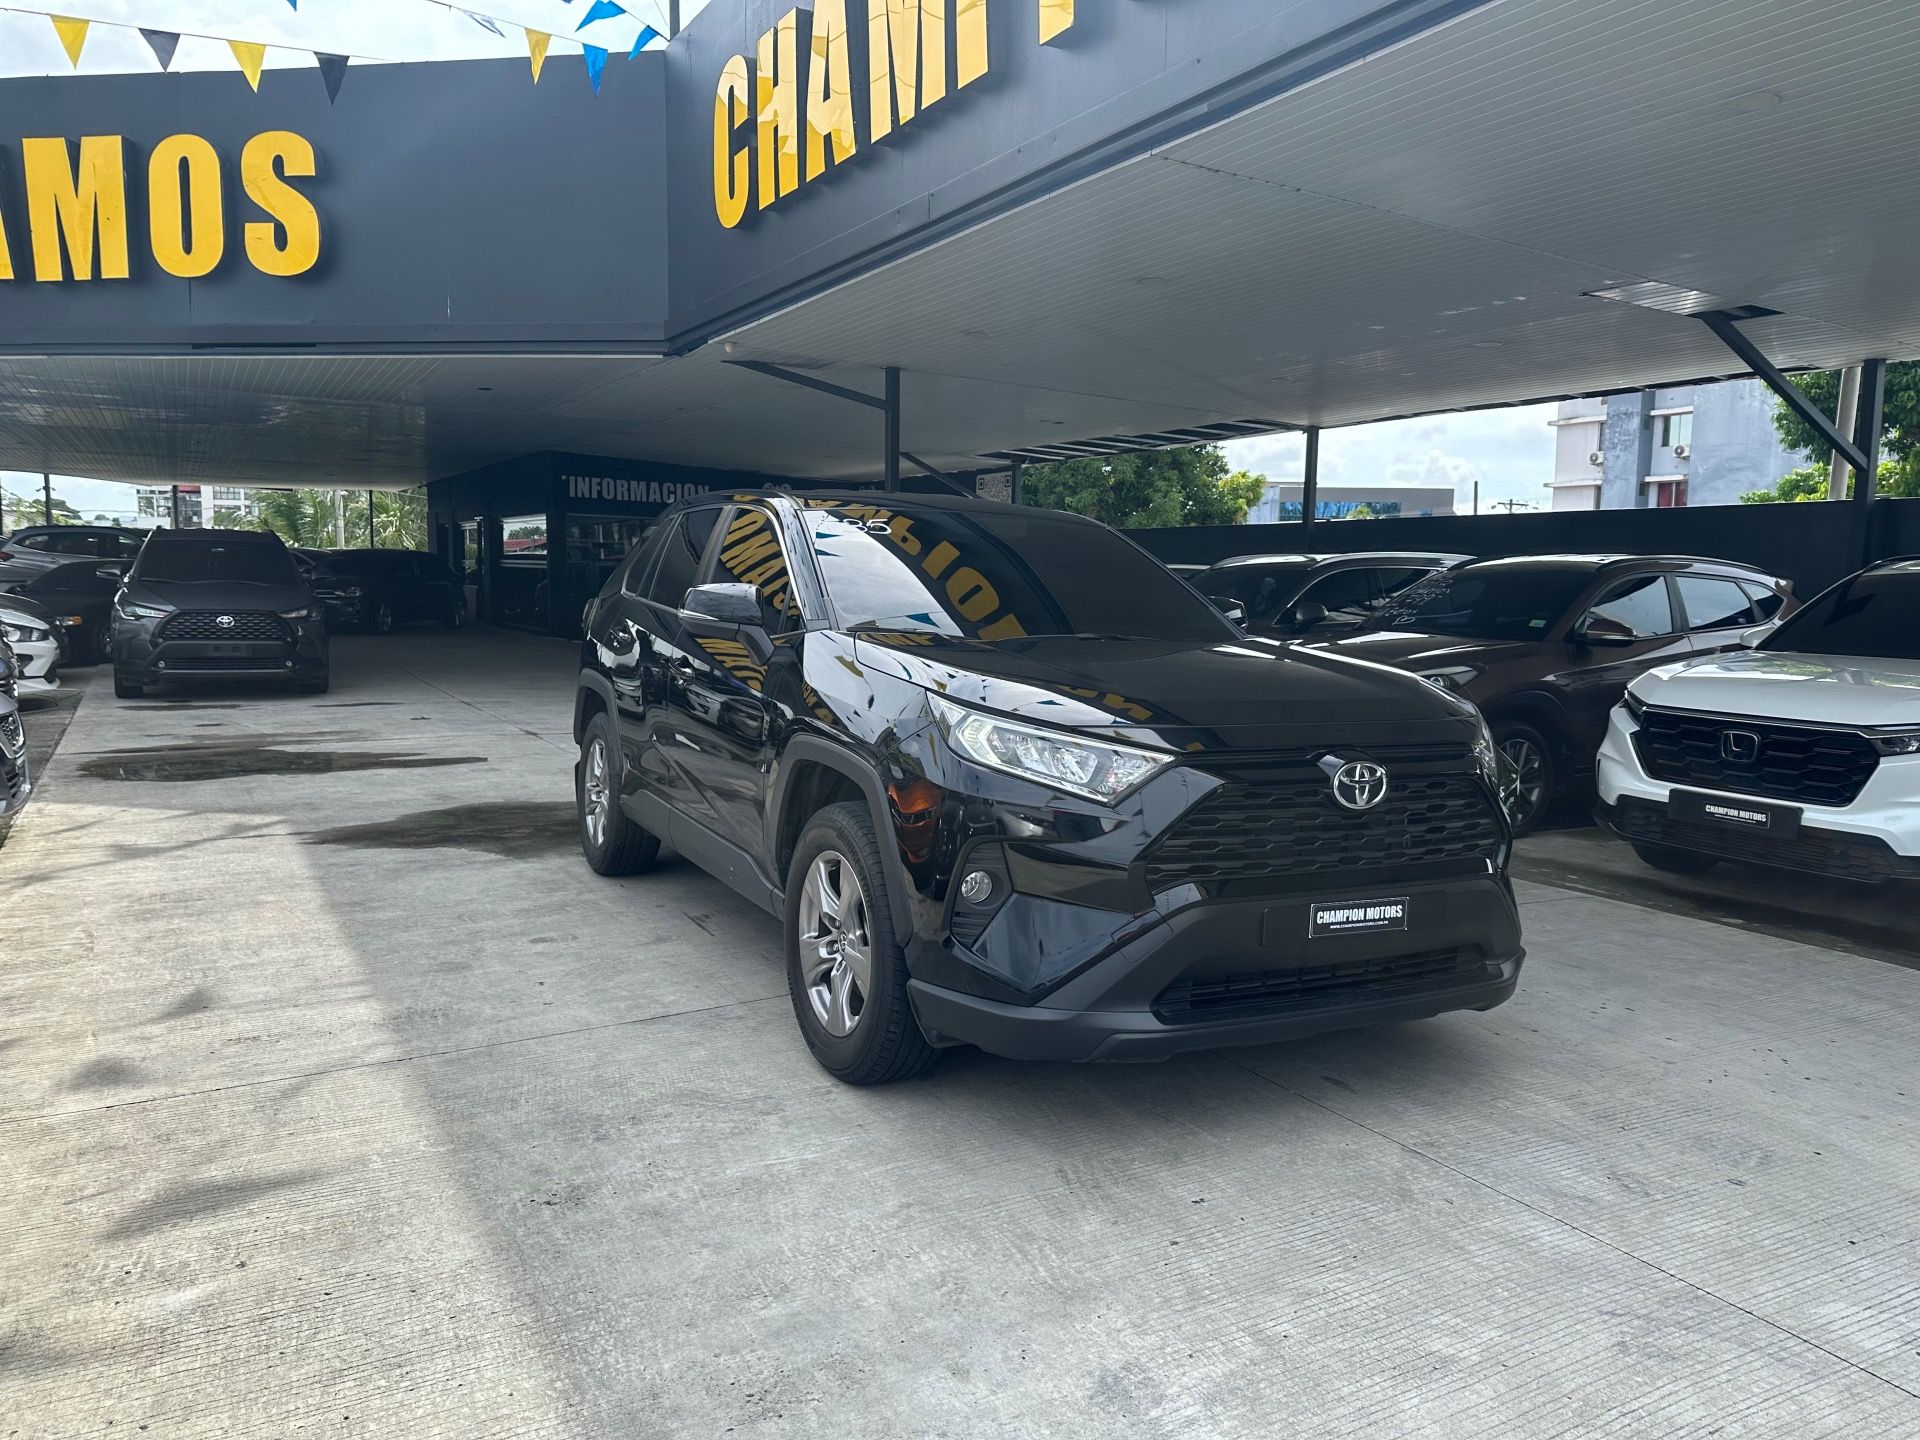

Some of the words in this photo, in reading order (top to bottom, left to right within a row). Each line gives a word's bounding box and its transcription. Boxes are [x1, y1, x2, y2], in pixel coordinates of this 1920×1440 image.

[714, 0, 1074, 229] CHAM
[0, 130, 320, 282] MOS
[1705, 804, 1738, 816] CHAMPION
[1739, 810, 1767, 822] MOTORS
[1316, 908, 1365, 923] CHAMPION
[1366, 905, 1402, 920] MOTORS
